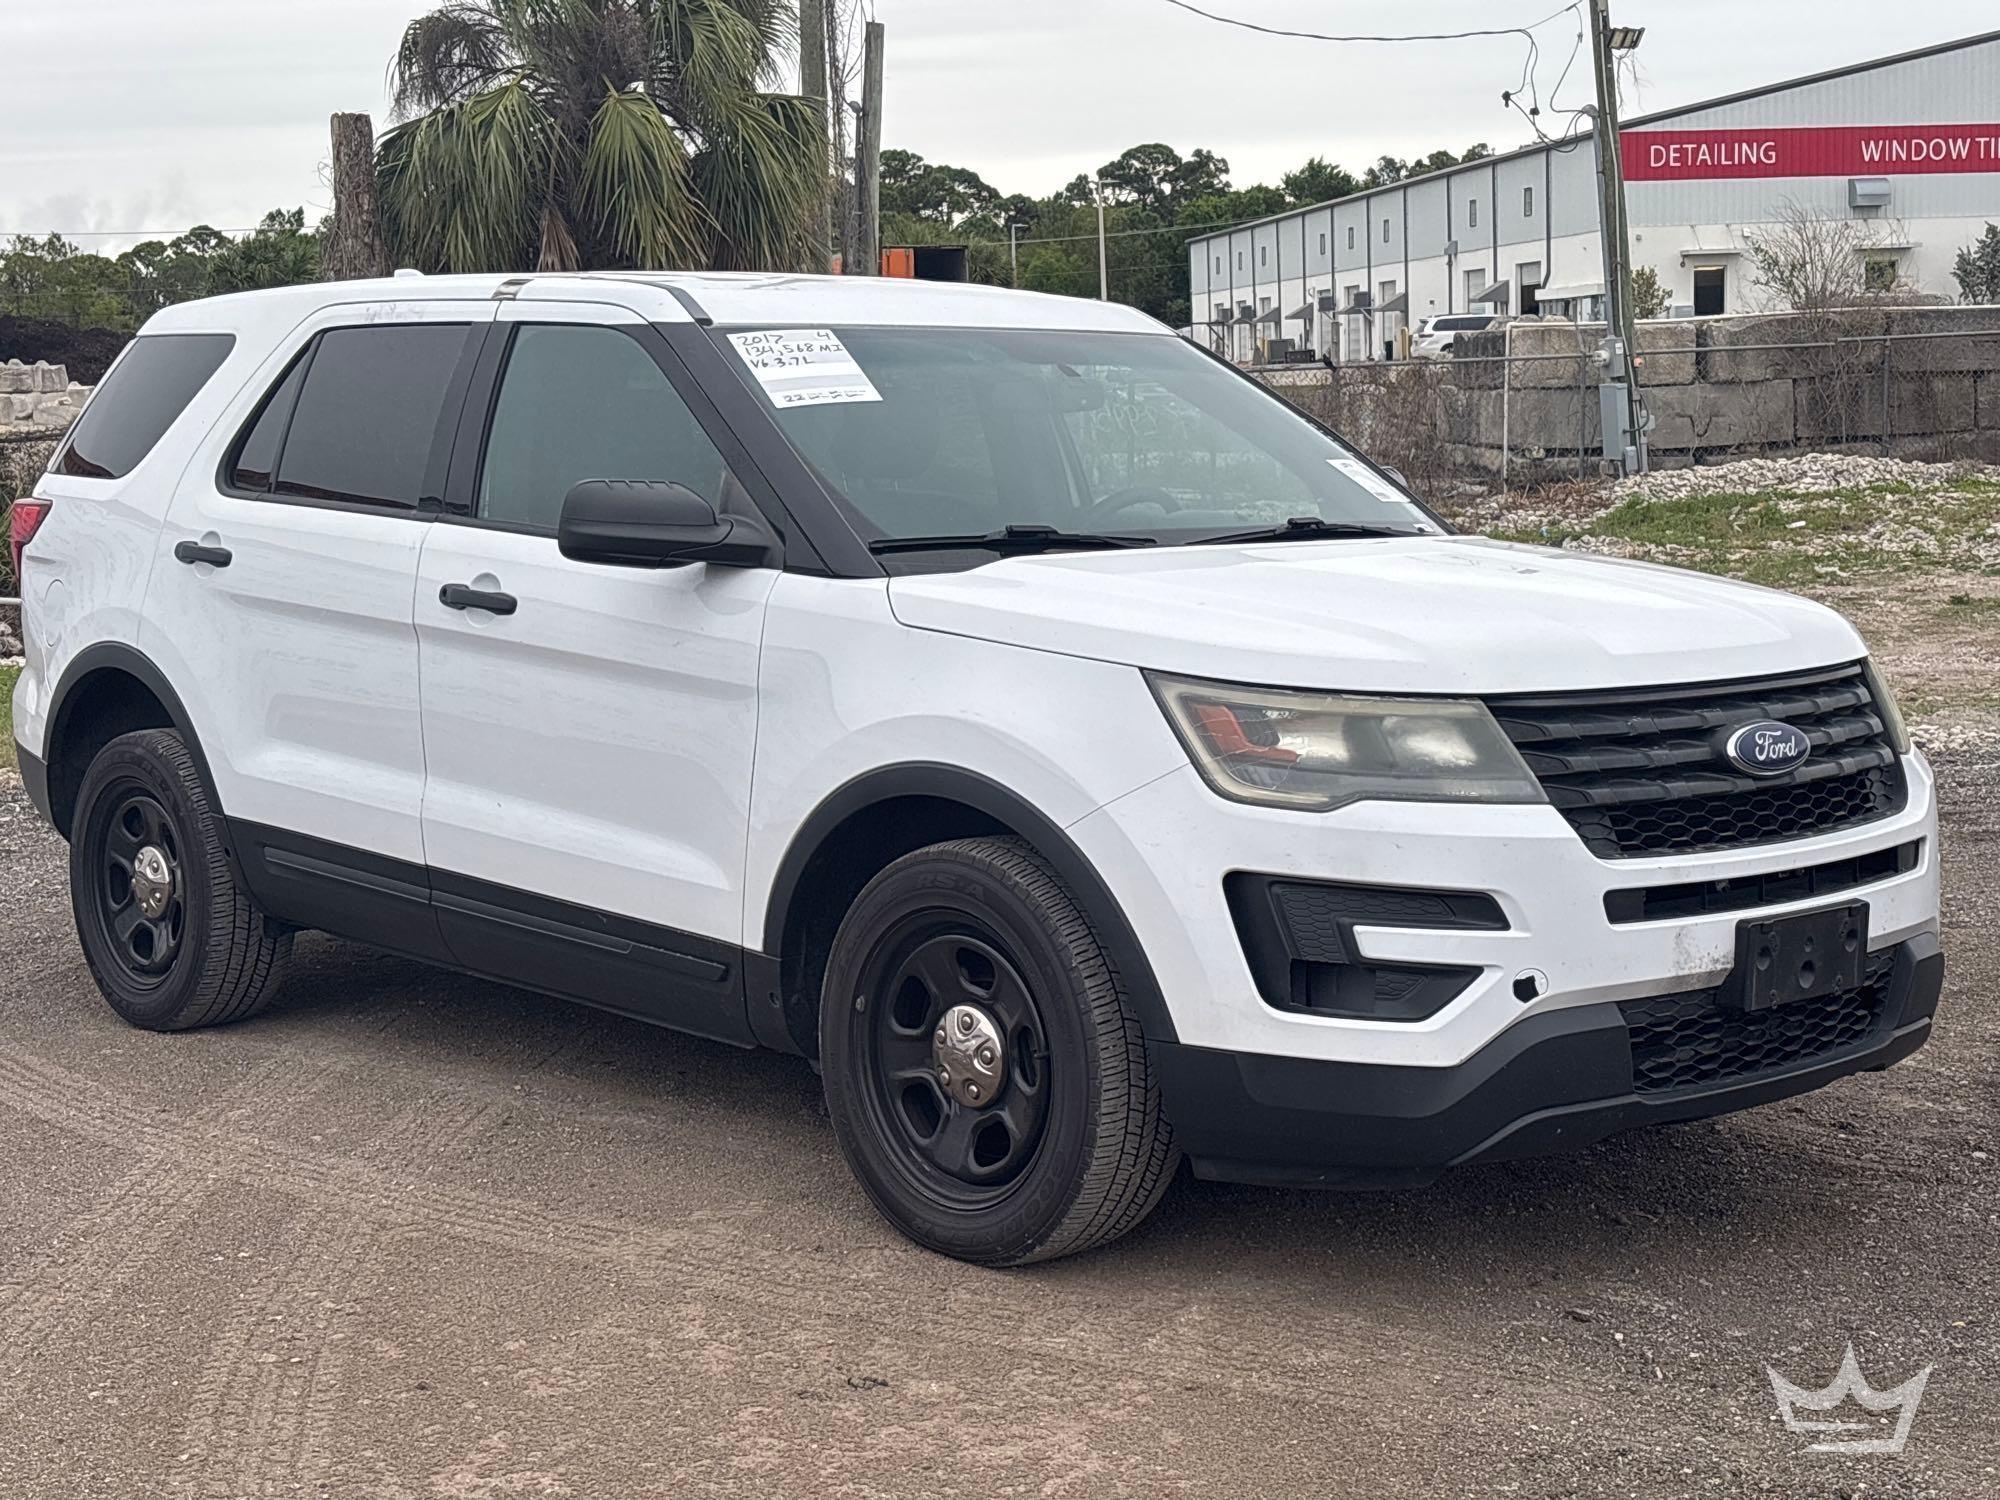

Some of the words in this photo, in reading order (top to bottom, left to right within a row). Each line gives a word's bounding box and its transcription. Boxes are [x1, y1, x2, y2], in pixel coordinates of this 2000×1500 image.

[1650, 142, 1776, 167] DETAILING
[1861, 137, 1971, 162] WINDOW
[1975, 137, 2000, 159] TI
[737, 333, 783, 346] 2017
[745, 343, 814, 357] 134,568
[750, 359, 768, 369] V6
[1755, 730, 1797, 761] Ford
